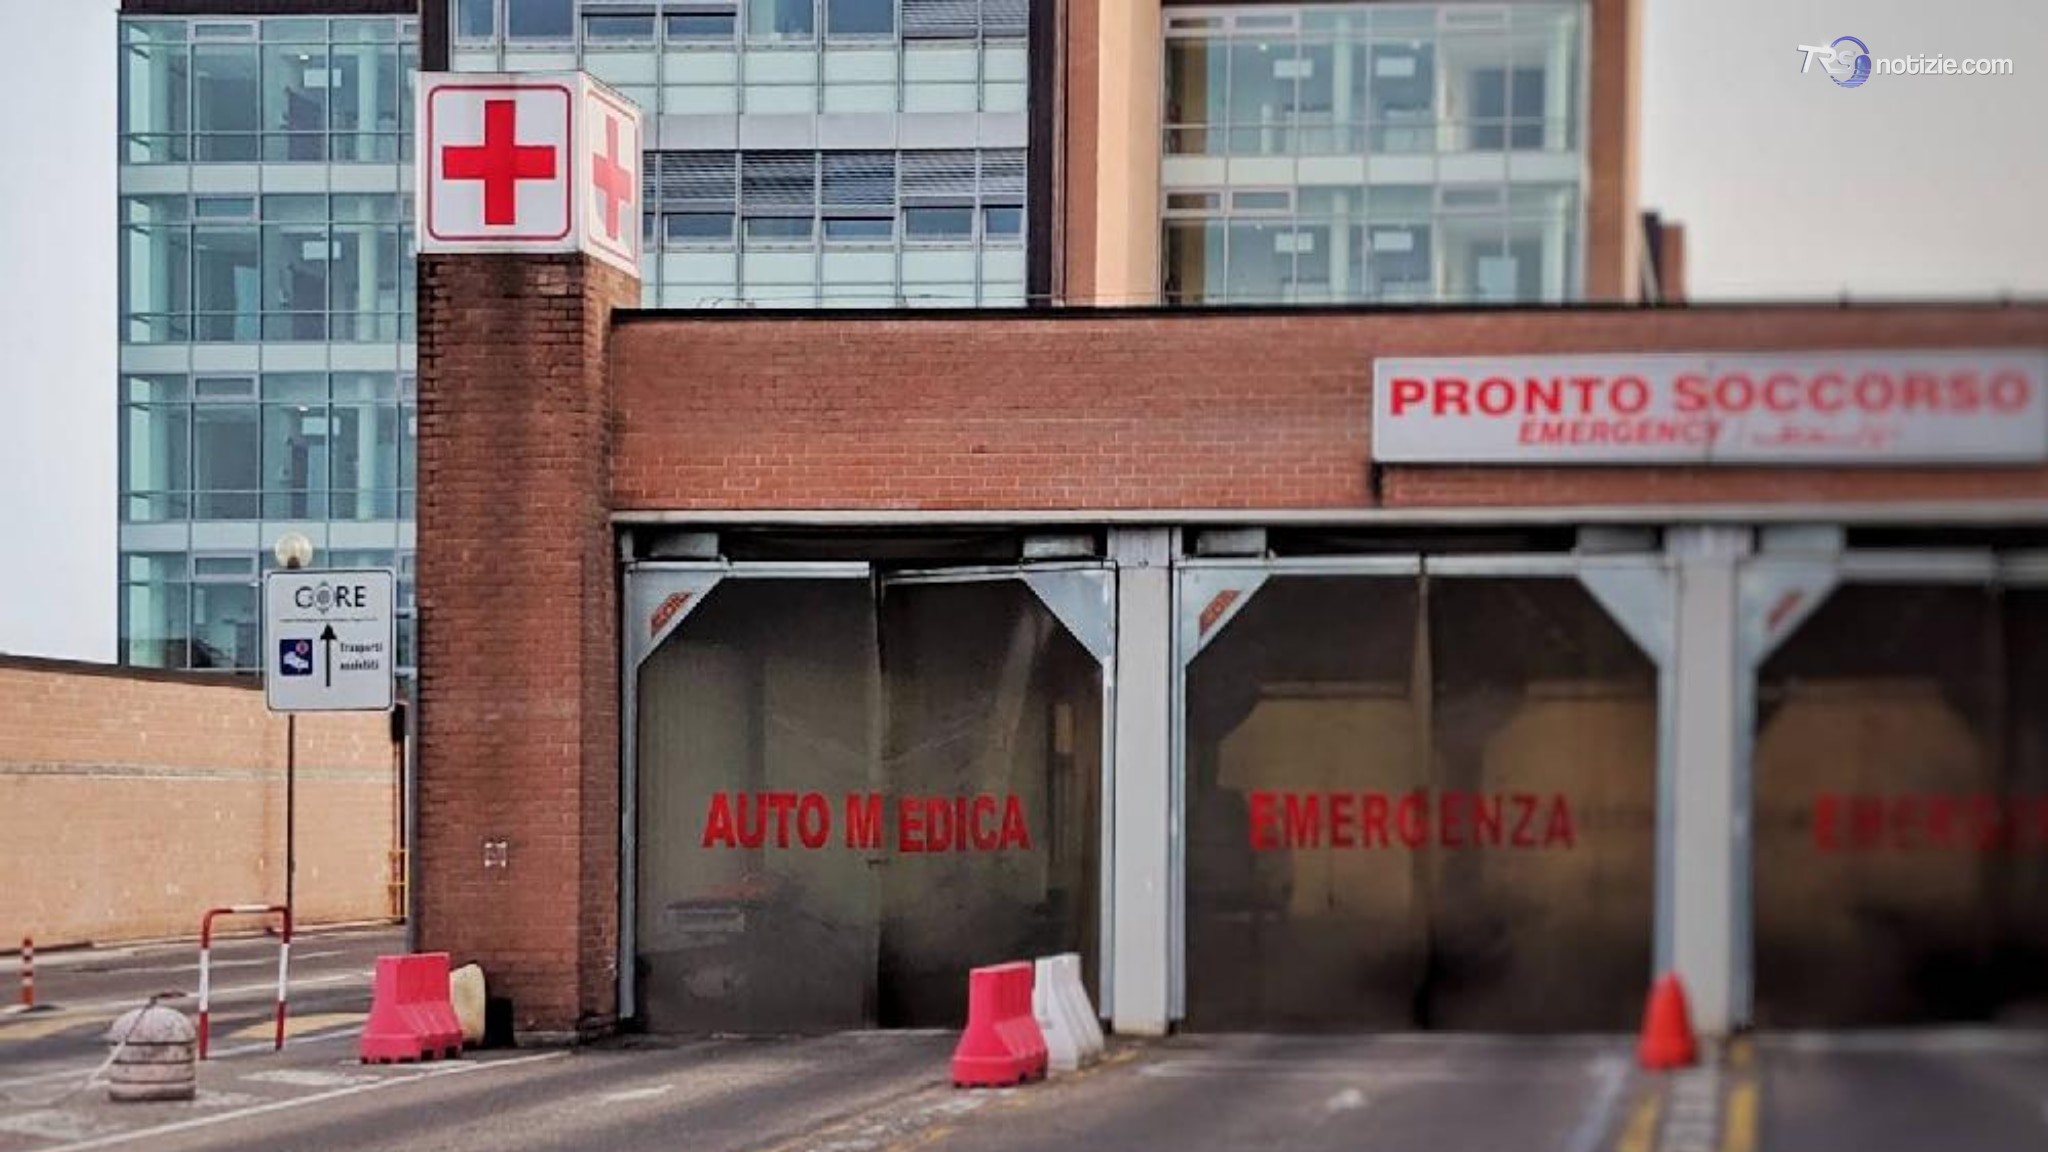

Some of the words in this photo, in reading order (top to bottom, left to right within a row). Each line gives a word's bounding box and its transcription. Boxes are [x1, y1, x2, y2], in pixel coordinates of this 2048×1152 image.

[1389, 377, 1650, 417] PRONTO
[1674, 371, 2031, 414] SOCCORSO
[1516, 420, 1721, 445] EMERGENCY
[295, 584, 367, 610] CORE
[702, 792, 831, 850] AUTO
[1250, 790, 1577, 849] EMERGENZA
